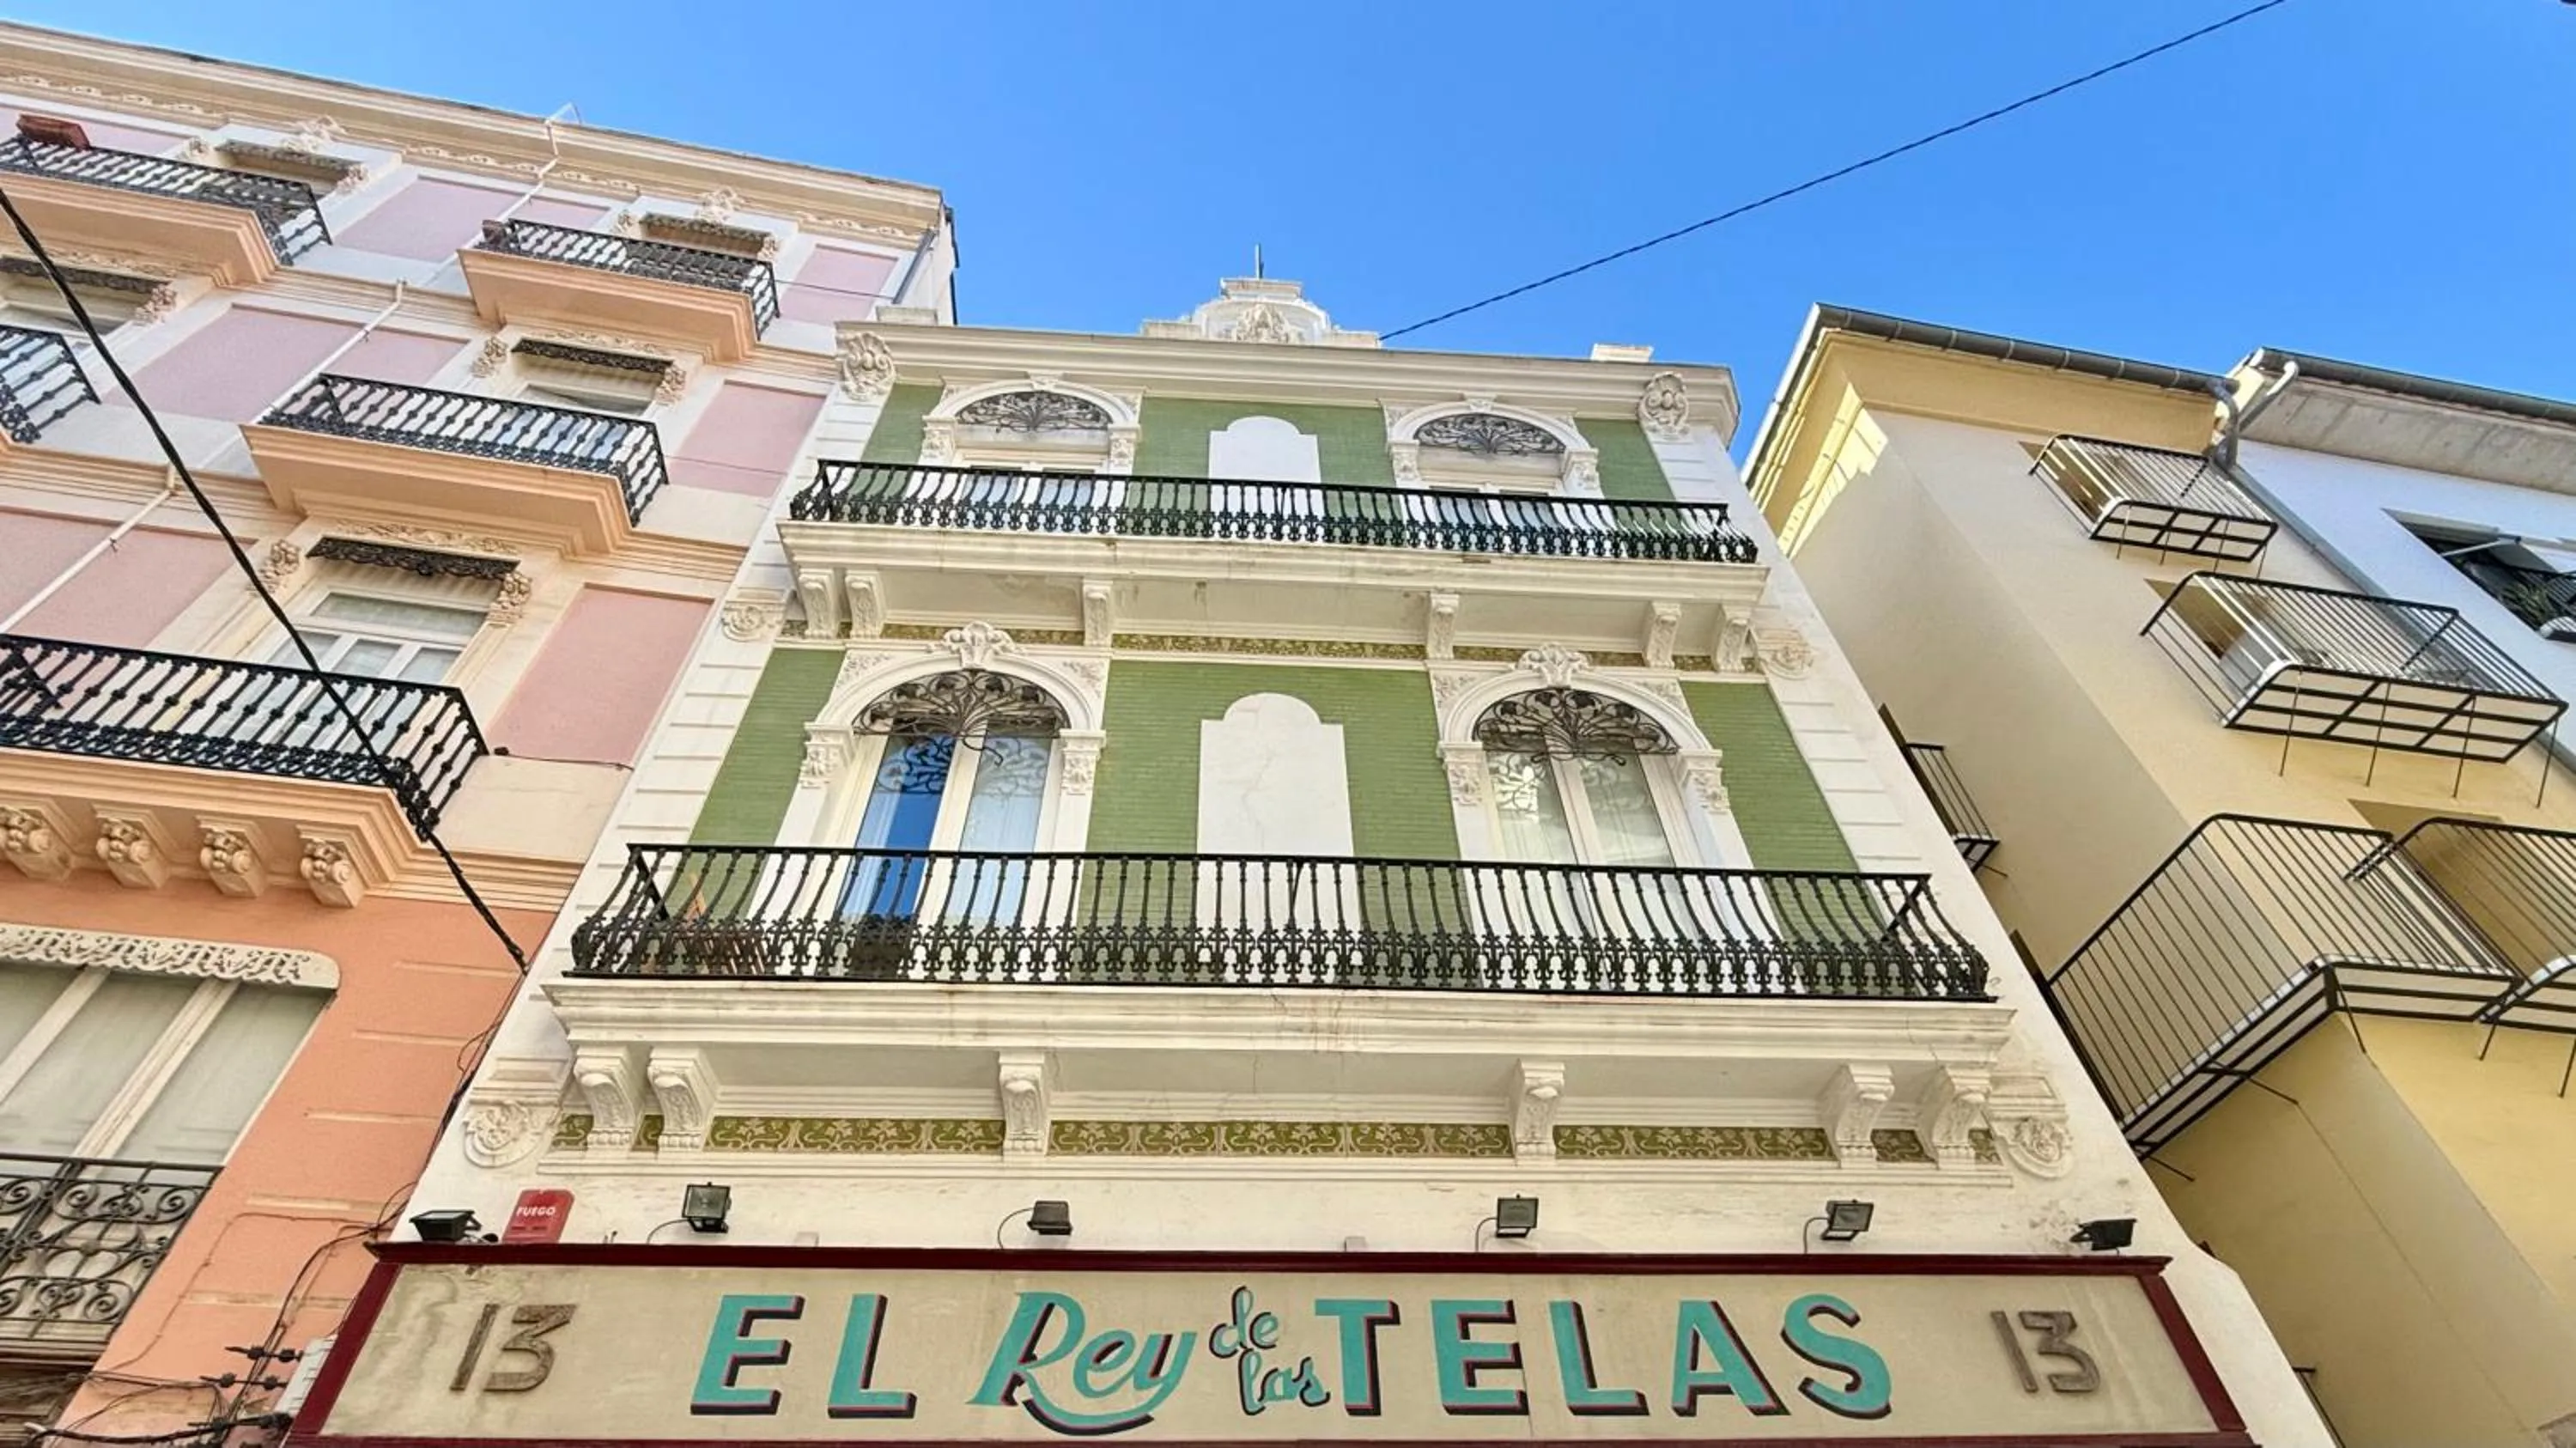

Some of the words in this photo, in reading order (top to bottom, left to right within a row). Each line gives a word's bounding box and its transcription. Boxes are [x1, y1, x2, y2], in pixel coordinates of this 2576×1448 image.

[515, 1205, 556, 1218] FUEGO
[449, 1302, 578, 1393] 13
[690, 1293, 917, 1420] EL
[966, 1291, 1198, 1437] Rey
[1209, 1286, 1280, 1359] de
[1315, 1293, 1893, 1421] TELAS
[1990, 1310, 2100, 1394] 13
[1238, 1348, 1331, 1416] las
